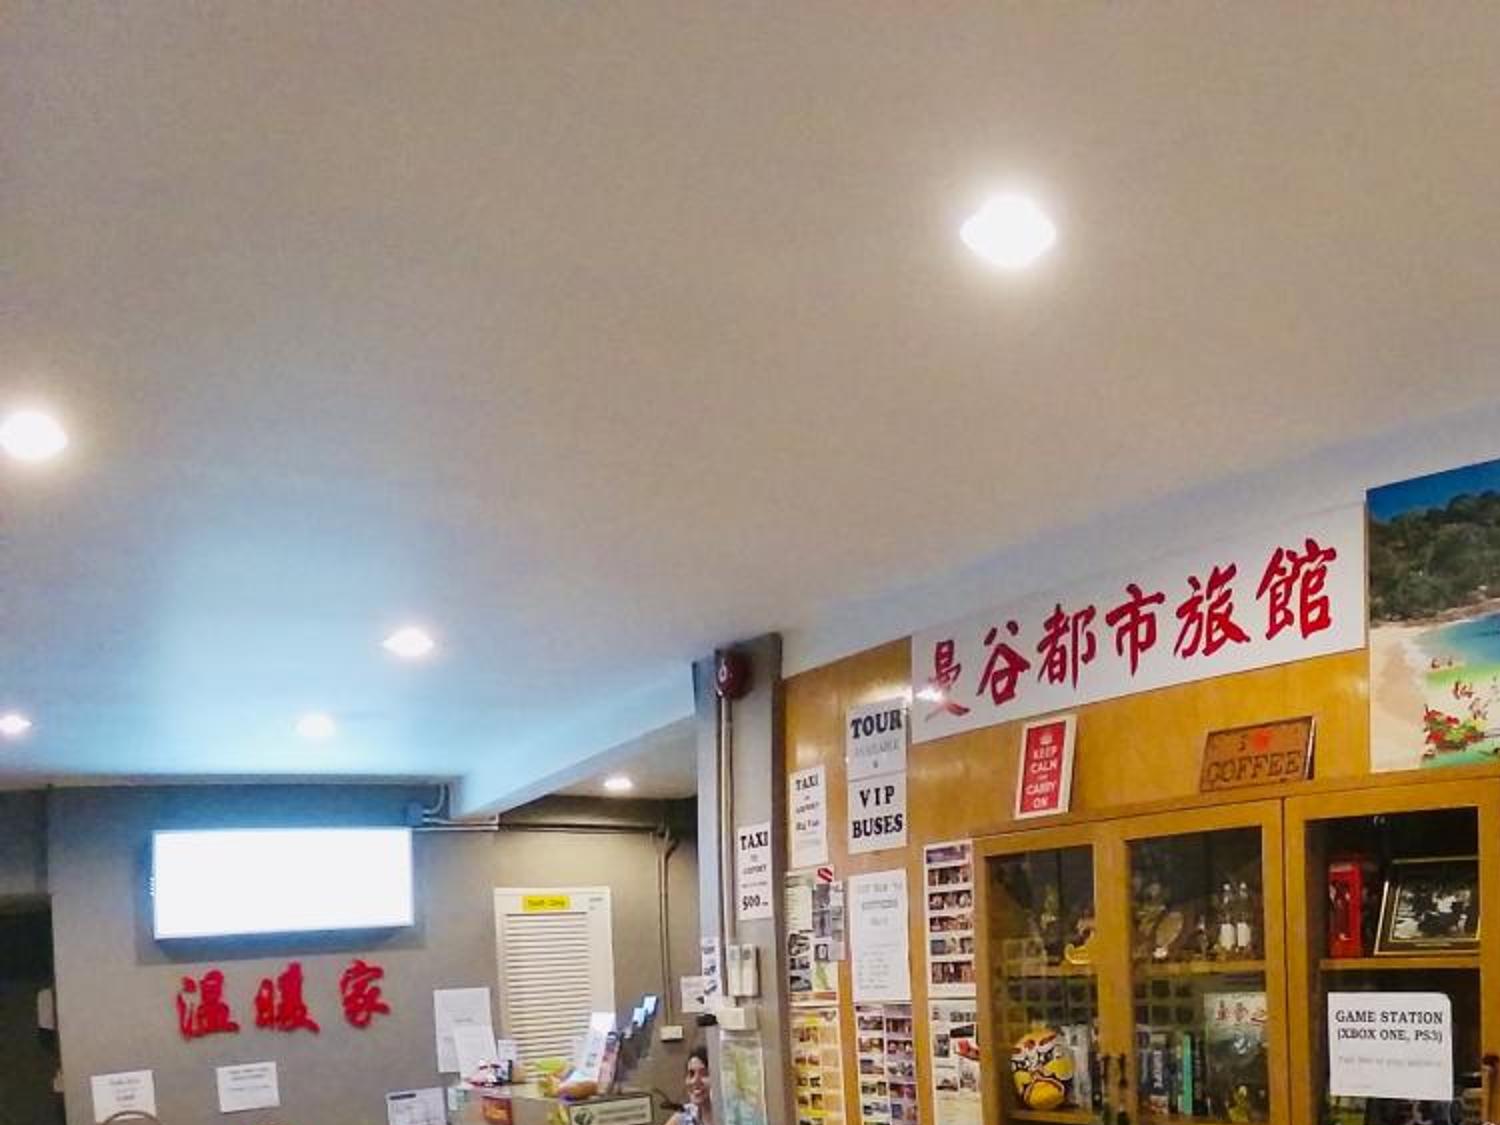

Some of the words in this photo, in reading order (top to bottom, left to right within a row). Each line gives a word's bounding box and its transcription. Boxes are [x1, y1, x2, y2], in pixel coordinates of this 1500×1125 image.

[851, 709, 902, 739] TOUR
[1033, 745, 1058, 759] KEEP
[1031, 758, 1057, 774] CALM
[1205, 750, 1301, 783] COFFEE
[795, 773, 819, 792] TAXI
[1025, 780, 1057, 795] CARRY
[1033, 796, 1049, 809] ON
[852, 813, 903, 839] BUSES
[740, 831, 768, 850] TAXI
[1335, 1010, 1376, 1023] GAME
[1380, 1011, 1443, 1024] STATION
[1337, 1028, 1376, 1040] (XBOX
[1379, 1029, 1411, 1041] ONE,
[1415, 1029, 1443, 1044] PS3)
